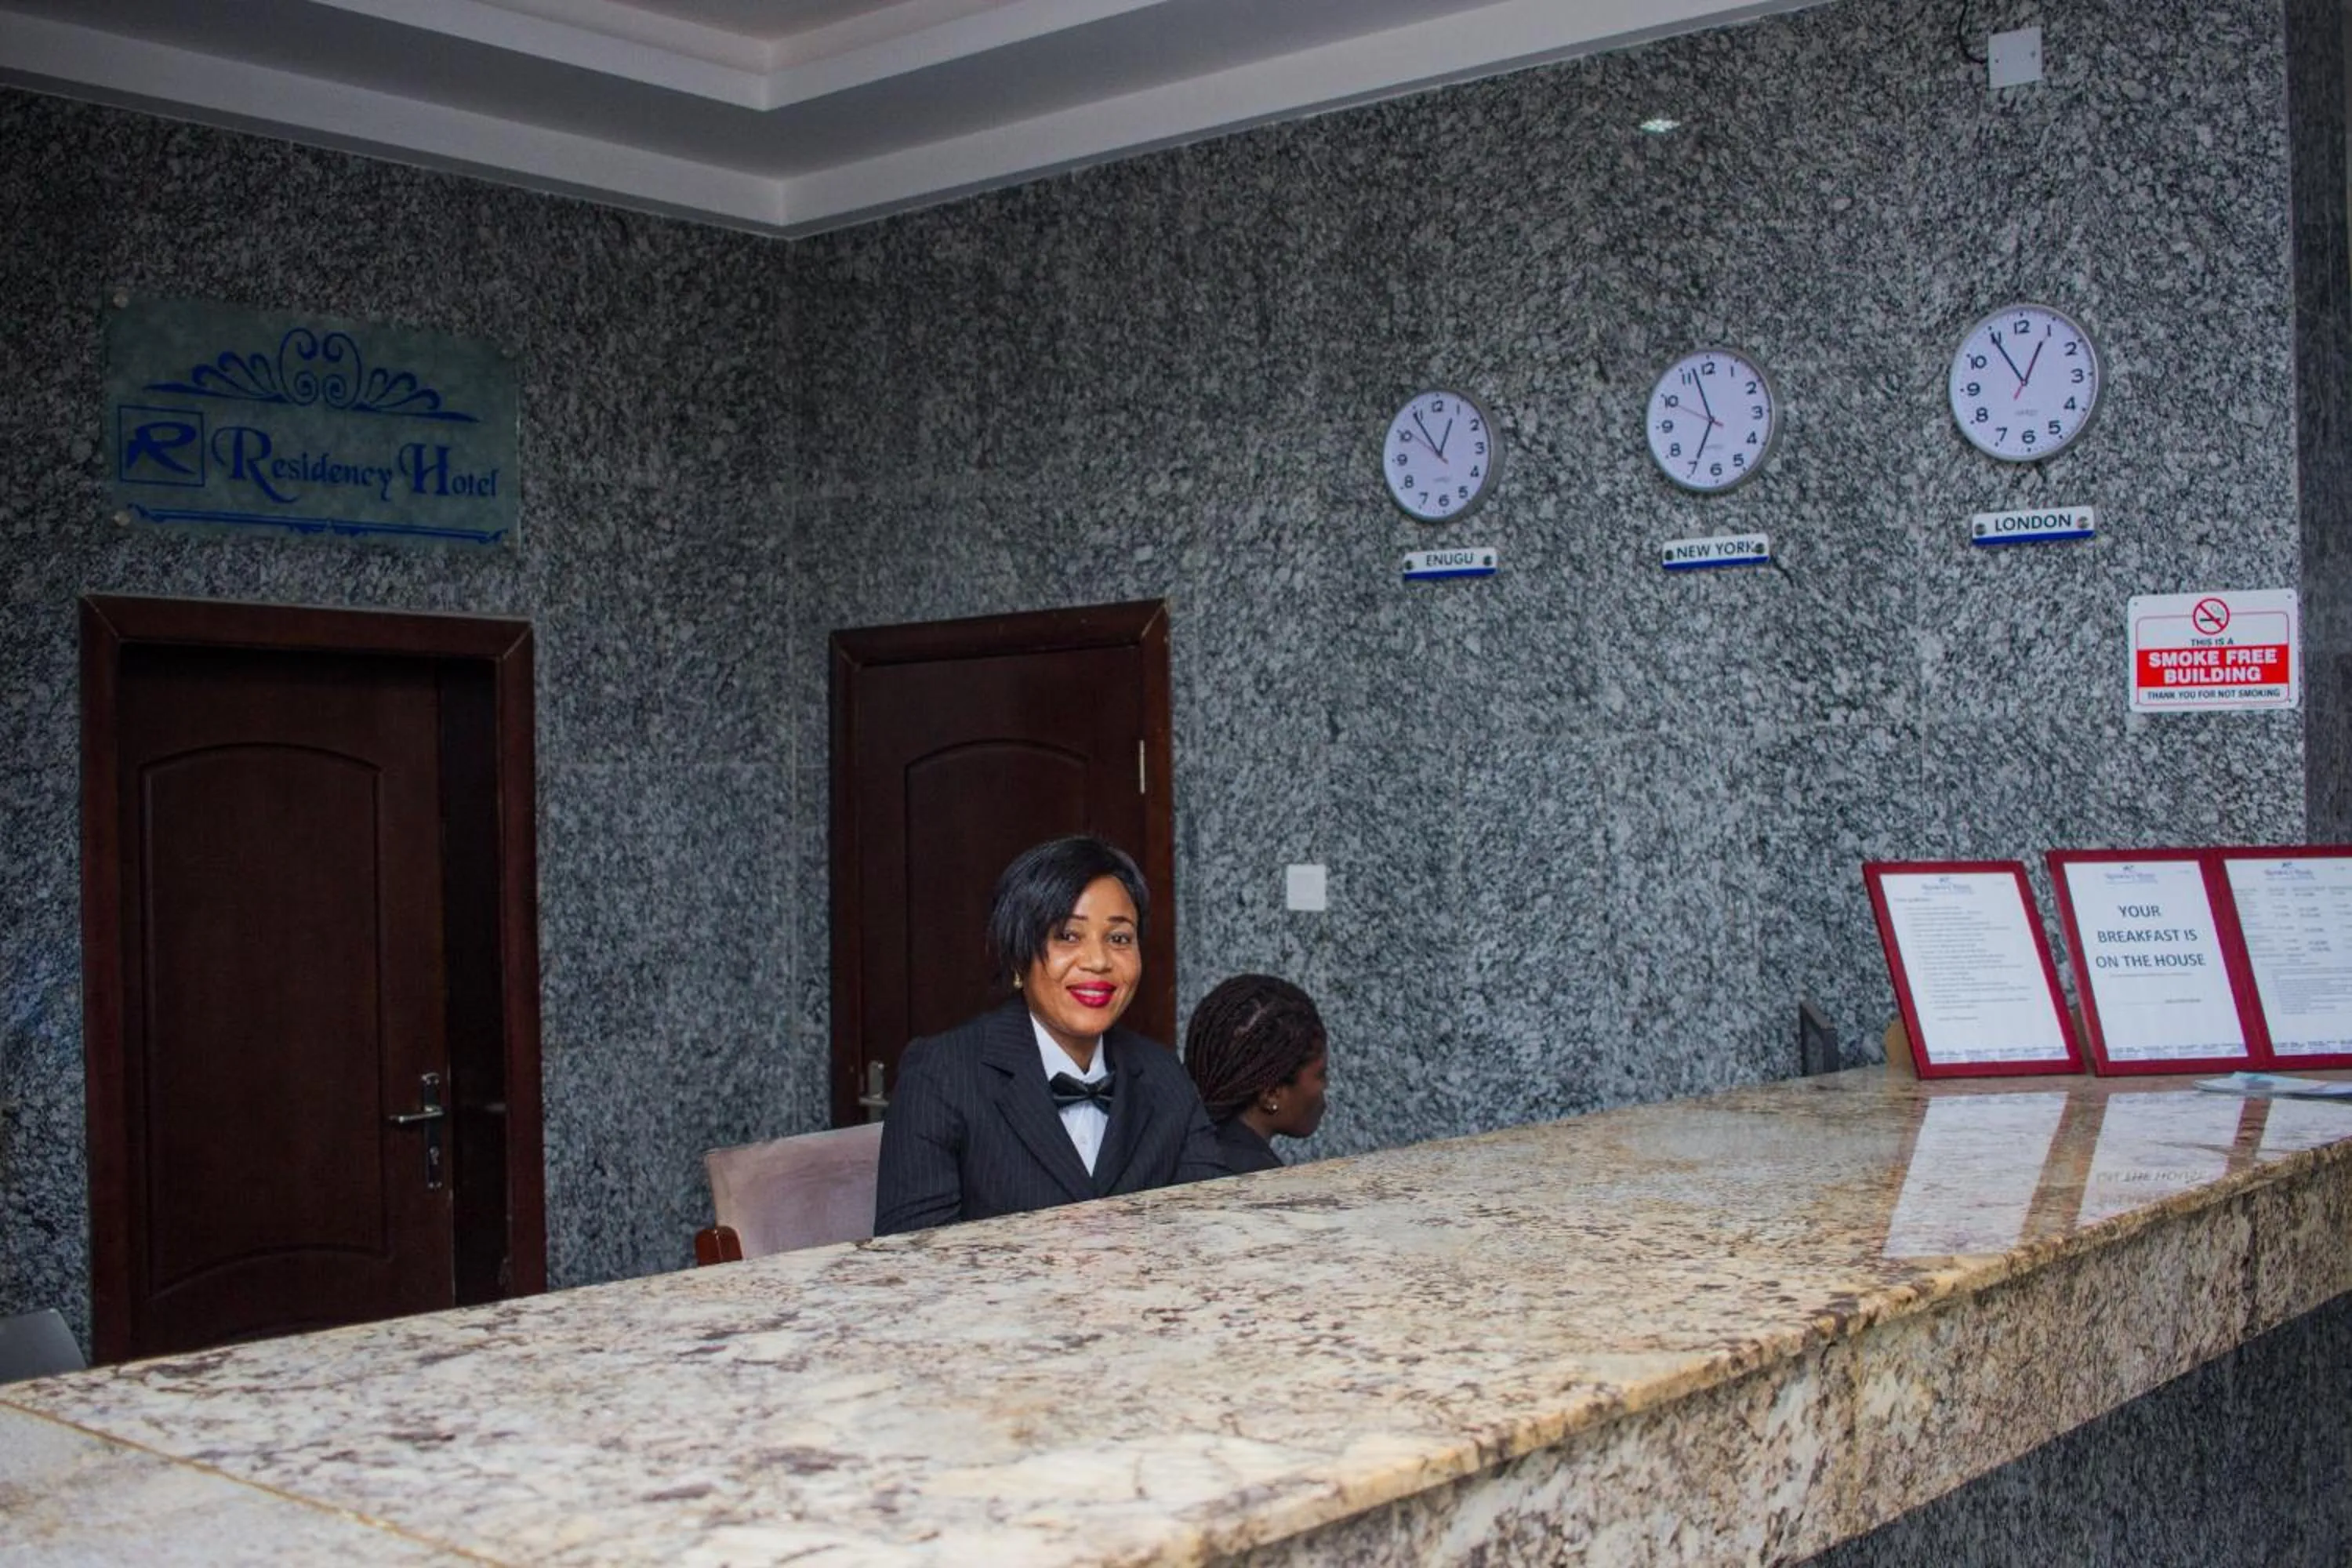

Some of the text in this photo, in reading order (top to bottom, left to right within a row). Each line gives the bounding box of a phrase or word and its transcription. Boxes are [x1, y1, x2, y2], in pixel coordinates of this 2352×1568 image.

[2013, 319, 2030, 335] 12
[2063, 341, 2078, 357] 2
[1700, 361, 1715, 376] 12
[1970, 354, 1987, 370] 10
[1681, 372, 1691, 386] 11
[2071, 368, 2084, 383] 3
[1745, 381, 1757, 395] 2
[1966, 382, 1980, 397] 9
[1432, 401, 1443, 412] 12
[1664, 394, 1679, 408] 10
[2063, 395, 2076, 411] 4
[1751, 405, 1763, 420] 3
[1975, 407, 1988, 423] 8
[1470, 419, 1479, 431] 2
[1661, 419, 1674, 434] 9
[2048, 419, 2061, 436] 5
[1399, 430, 1412, 442] 10
[1746, 431, 1757, 445] 4
[1995, 426, 2008, 442] 7
[2022, 429, 2035, 445] 6
[1475, 442, 1484, 455] 3
[1670, 442, 1681, 458] 8
[211, 426, 499, 503] Residency Hotel
[1396, 454, 1408, 466] 9
[1733, 453, 1744, 467] 5
[1470, 466, 1479, 477] 4
[1687, 460, 1697, 475] 7
[1710, 463, 1722, 477] 6
[1404, 475, 1414, 488] 8
[1419, 492, 1428, 506] 7
[1458, 485, 1468, 499] 5
[1439, 495, 1450, 507] 6
[1994, 514, 2072, 532] LONDON
[1676, 544, 1709, 558] NEW
[1426, 552, 1474, 567] ENUGU
[2191, 638, 2212, 647] THIS
[2215, 637, 2225, 646] IS
[2148, 648, 2278, 667] SMOKE FREE
[2164, 666, 2261, 684] BUILDING
[2147, 688, 2280, 700] THANK YOU FOR NOT SMOKING
[2118, 905, 2161, 918] YOUR
[2097, 928, 2198, 942] BREAKFAST IS
[2096, 953, 2206, 968] ON THE HOUSE
